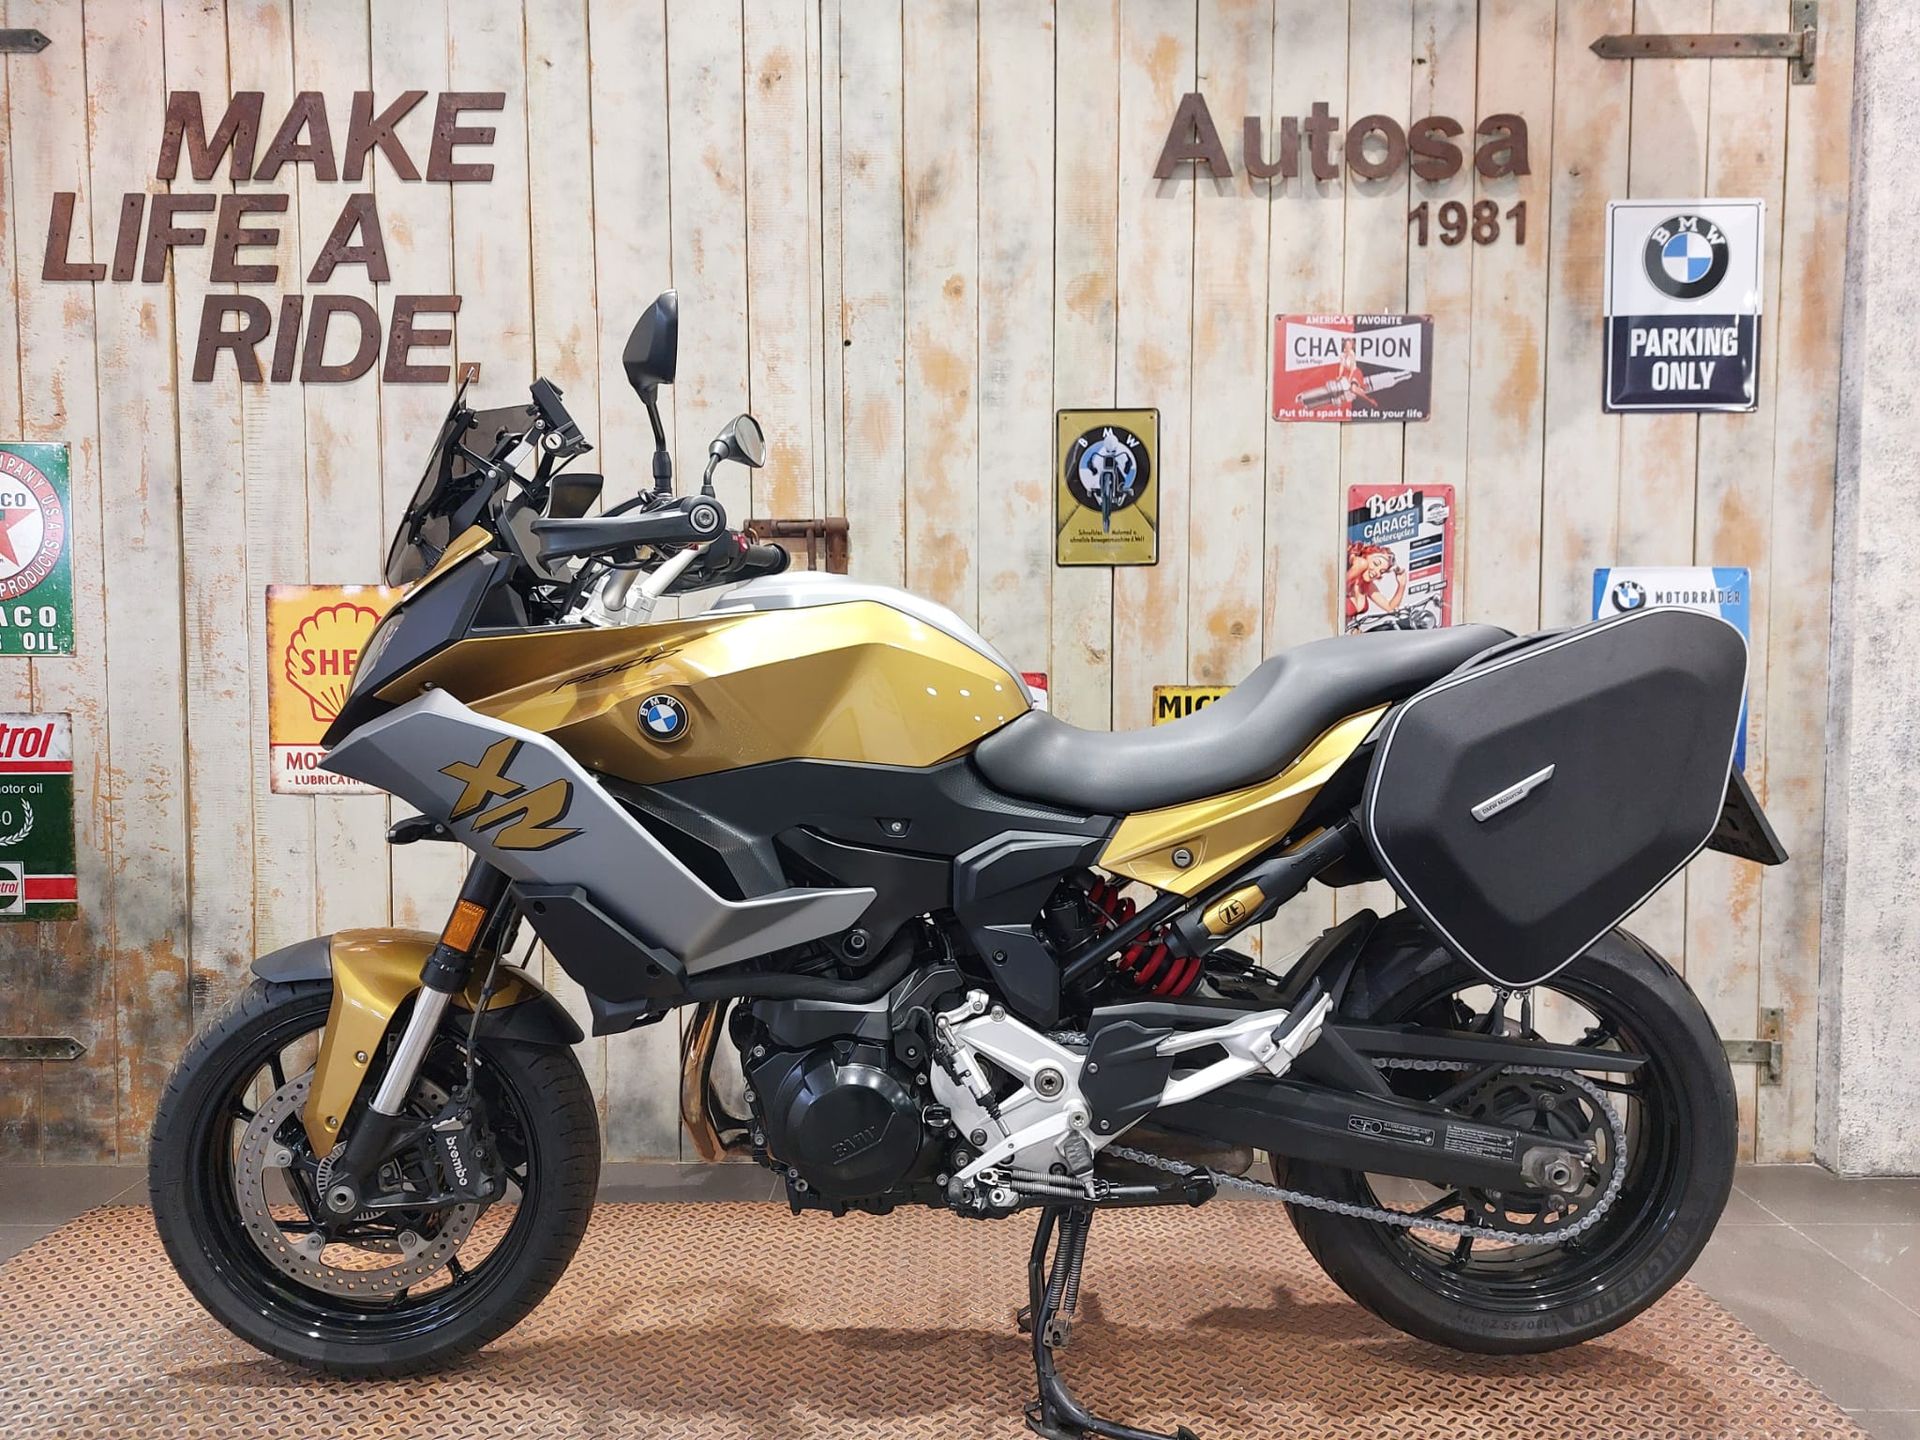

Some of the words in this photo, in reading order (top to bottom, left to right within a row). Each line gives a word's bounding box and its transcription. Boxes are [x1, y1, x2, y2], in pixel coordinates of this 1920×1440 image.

[156, 91, 505, 182] MAKE
[1154, 92, 1532, 181] Autosa
[42, 192, 289, 282] LIFE
[307, 193, 391, 282] A
[1407, 200, 1527, 247] 1981
[1652, 216, 1726, 246] BMW
[1306, 316, 1354, 325] AMERICA'S
[1356, 316, 1403, 325] FAVORITE
[192, 294, 481, 383] RIDE.
[1630, 327, 1738, 357] PARKING
[1651, 361, 1716, 391] ONLY
[1279, 409, 1296, 417] Put
[1298, 408, 1314, 417] the
[1317, 408, 1343, 419] spark
[1346, 408, 1369, 418] back
[1371, 409, 1381, 418] in
[1382, 410, 1406, 419] your
[1407, 409, 1423, 418] life
[1078, 427, 1140, 448] BMW
[1366, 488, 1415, 519] Best
[1364, 512, 1416, 538] GARAGE
[1655, 588, 1741, 606] MOTORRÄDER
[22, 631, 58, 650] OIL
[301, 649, 358, 676] SHE
[639, 695, 677, 717] BMW
[1159, 696, 1222, 719] MIC
[0, 784, 26, 794] otor
[28, 783, 43, 794] oil
[1482, 802, 1498, 815] BMW
[1498, 788, 1524, 806] Motorrad
[1220, 900, 1245, 924] ZF
[445, 1135, 468, 1186] brembo
[1572, 1226, 1689, 1325] MICHELIN
